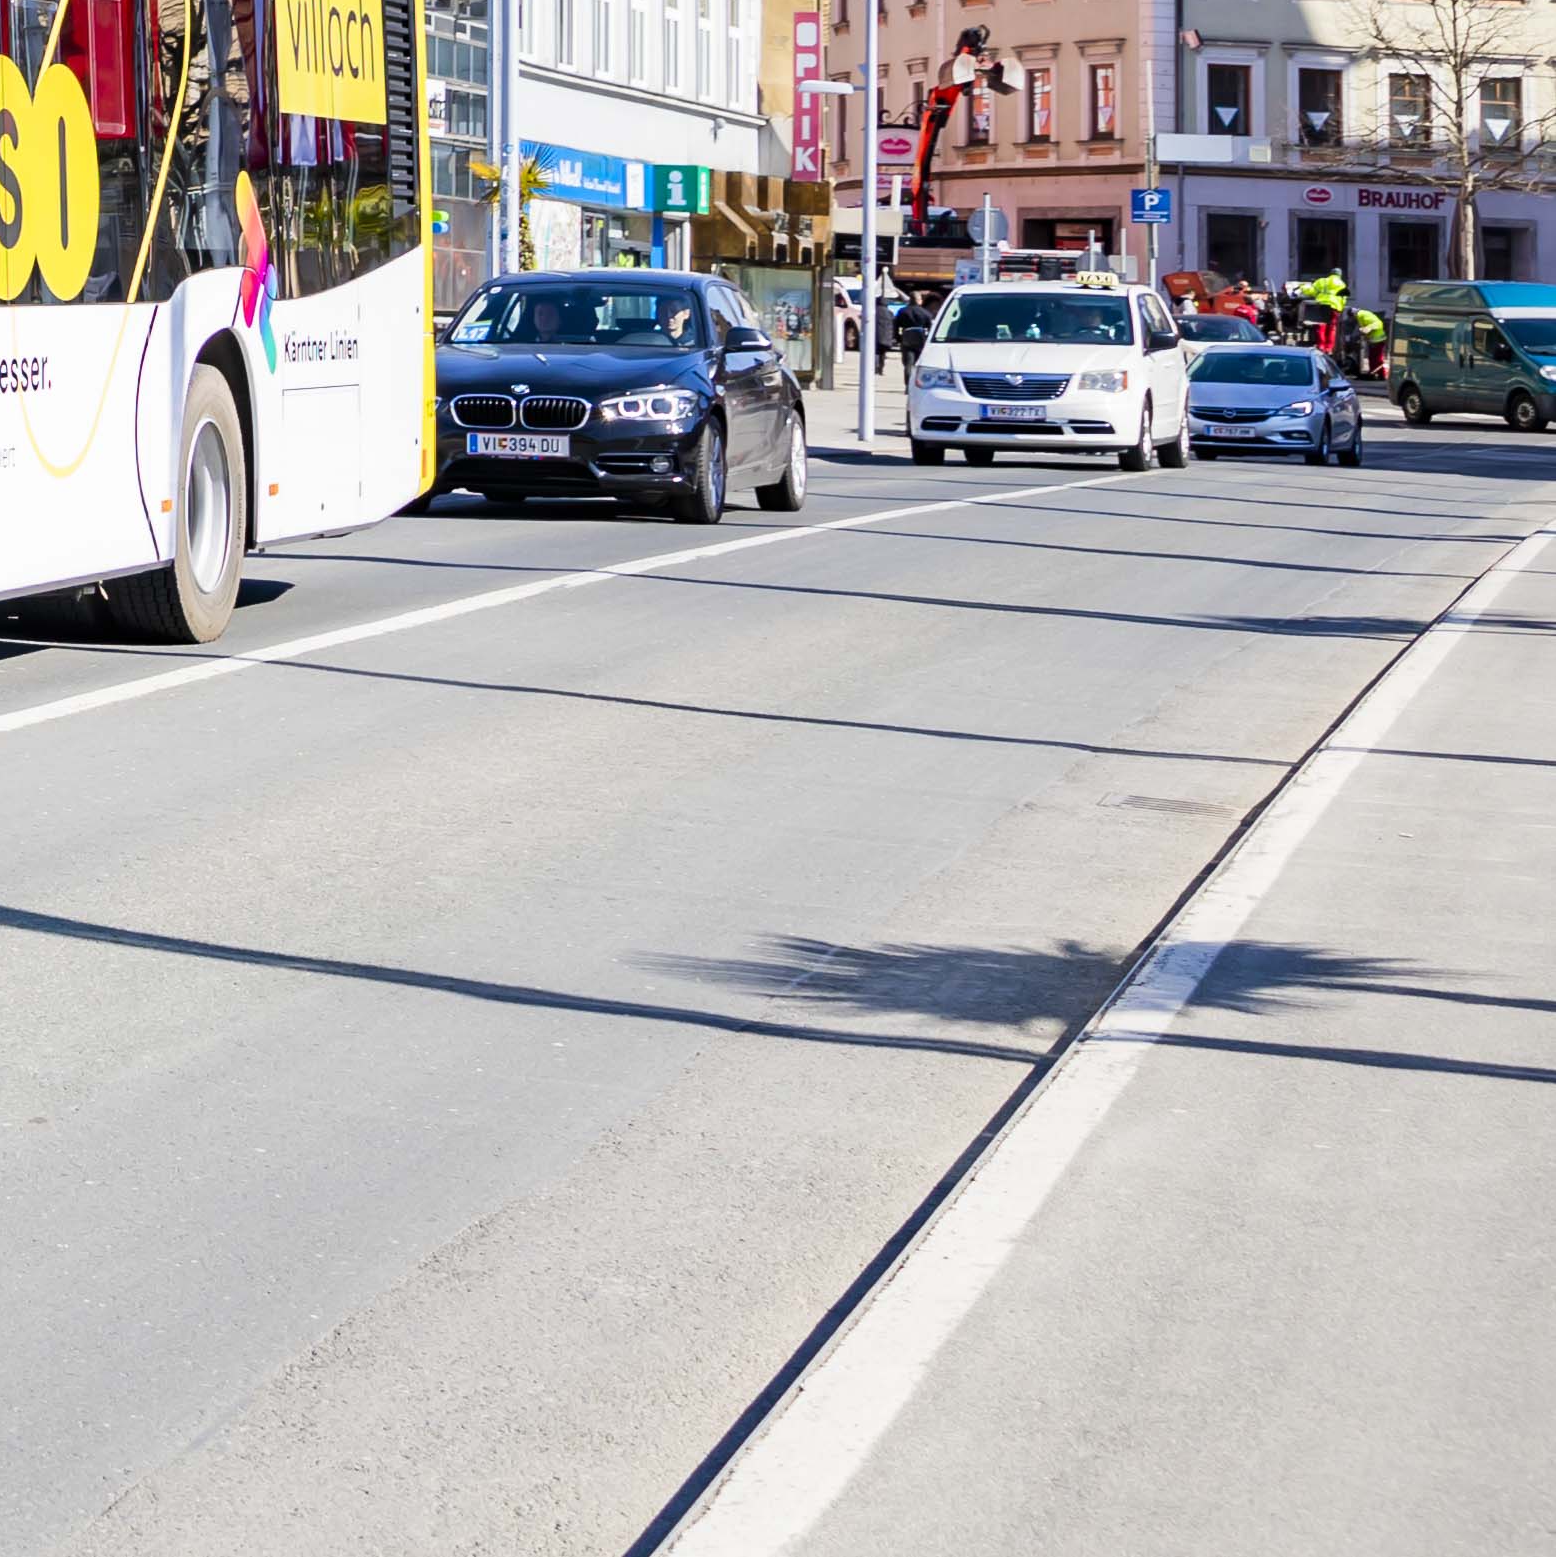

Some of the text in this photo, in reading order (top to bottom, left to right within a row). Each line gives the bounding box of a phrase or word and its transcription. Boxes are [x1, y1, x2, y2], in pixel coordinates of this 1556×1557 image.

[1358, 188, 1446, 211] BRAUHOF
[284, 329, 358, 363] Kärntner Linien
